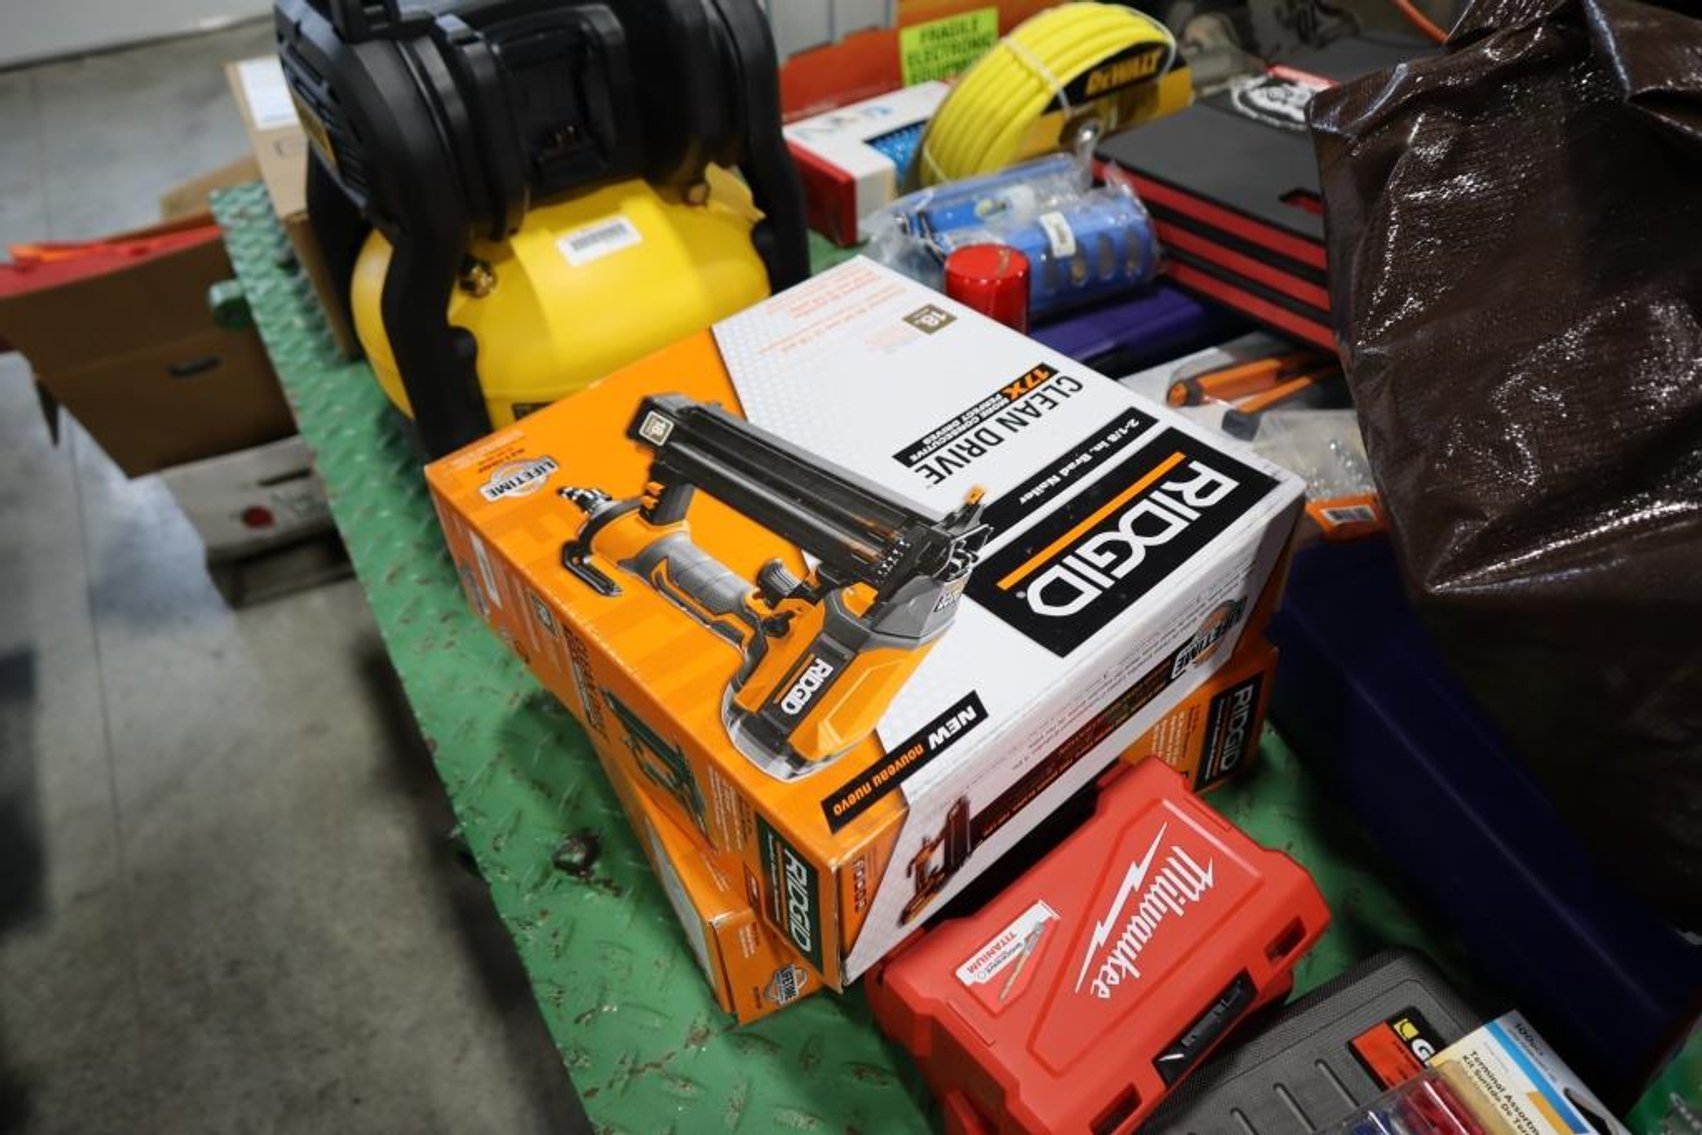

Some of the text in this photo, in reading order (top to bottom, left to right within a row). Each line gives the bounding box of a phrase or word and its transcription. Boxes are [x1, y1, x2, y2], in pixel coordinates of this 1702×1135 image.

[919, 20, 978, 43] FRAGILE
[1002, 368, 1051, 400] 17X
[909, 397, 1010, 462] MORE CONSECUTIVE
[914, 375, 1084, 485] CLEAN DRIVE
[921, 393, 1002, 445] PERFECT DRIVES
[1106, 418, 1140, 444] 2-1/8
[487, 459, 556, 500] LIFETIME
[1059, 453, 1093, 477] Brad
[1019, 475, 1061, 505] Nailer
[1027, 460, 1240, 617] RIDGID
[781, 657, 834, 716] RIDGID
[1220, 684, 1256, 771] RIDGID
[832, 705, 978, 816] NEW nouveau nuevo
[784, 849, 812, 953] RIDGID
[1090, 846, 1214, 999] Milwaukee
[966, 930, 1017, 974] TITANIUM
[1462, 1054, 1476, 1068] Kit
[1470, 1050, 1505, 1093] Terminal
